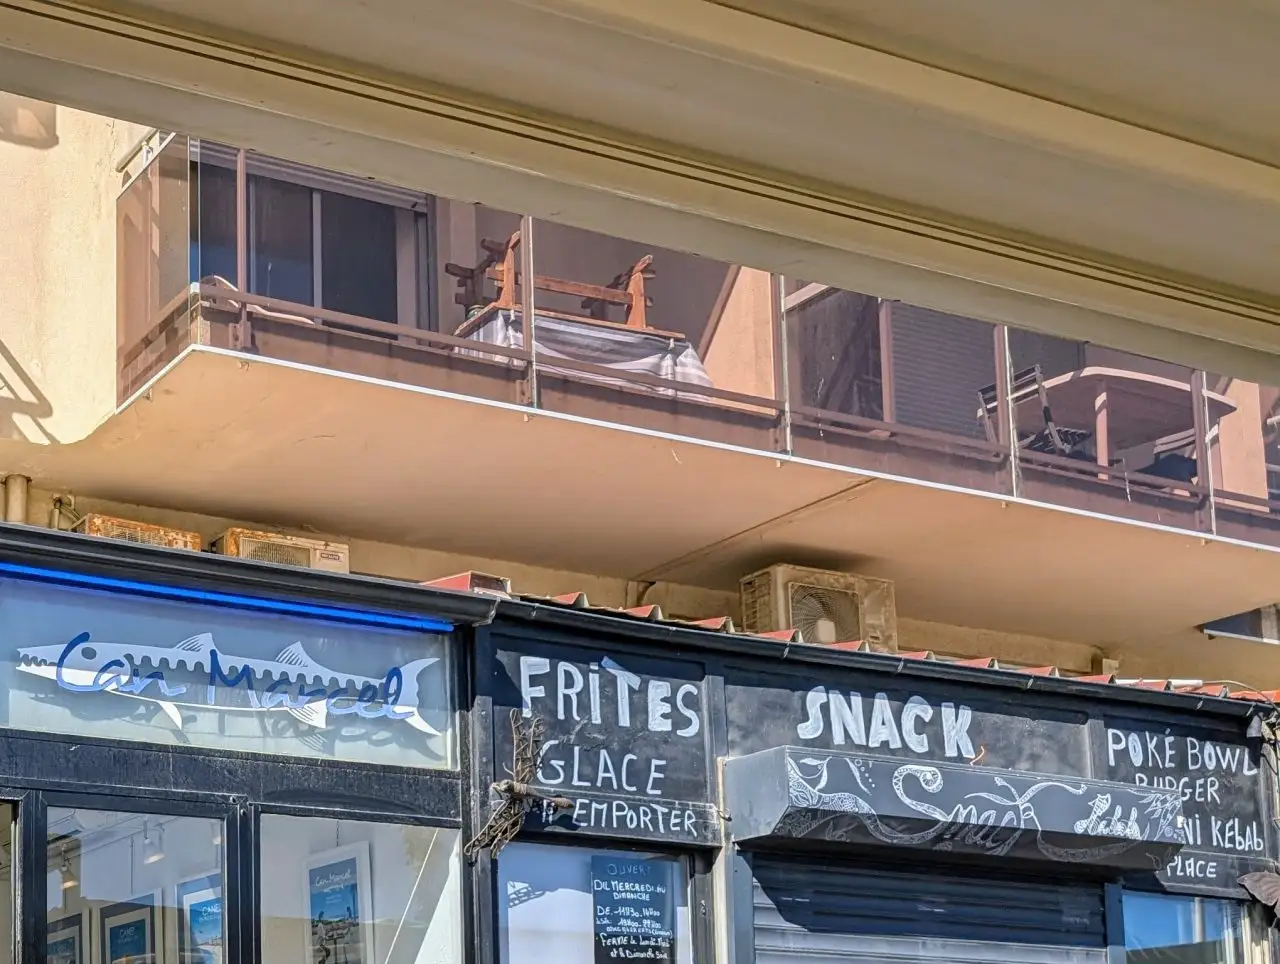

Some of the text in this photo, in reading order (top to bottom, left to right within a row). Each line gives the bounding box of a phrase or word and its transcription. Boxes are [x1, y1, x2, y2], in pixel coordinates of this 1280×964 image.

[57, 631, 415, 719] Can Marcel
[797, 686, 975, 759] SNACK
[537, 740, 667, 795] GLACE
[1107, 728, 1258, 776] POKÉ BOWL
[572, 799, 698, 837] EMPORTER
